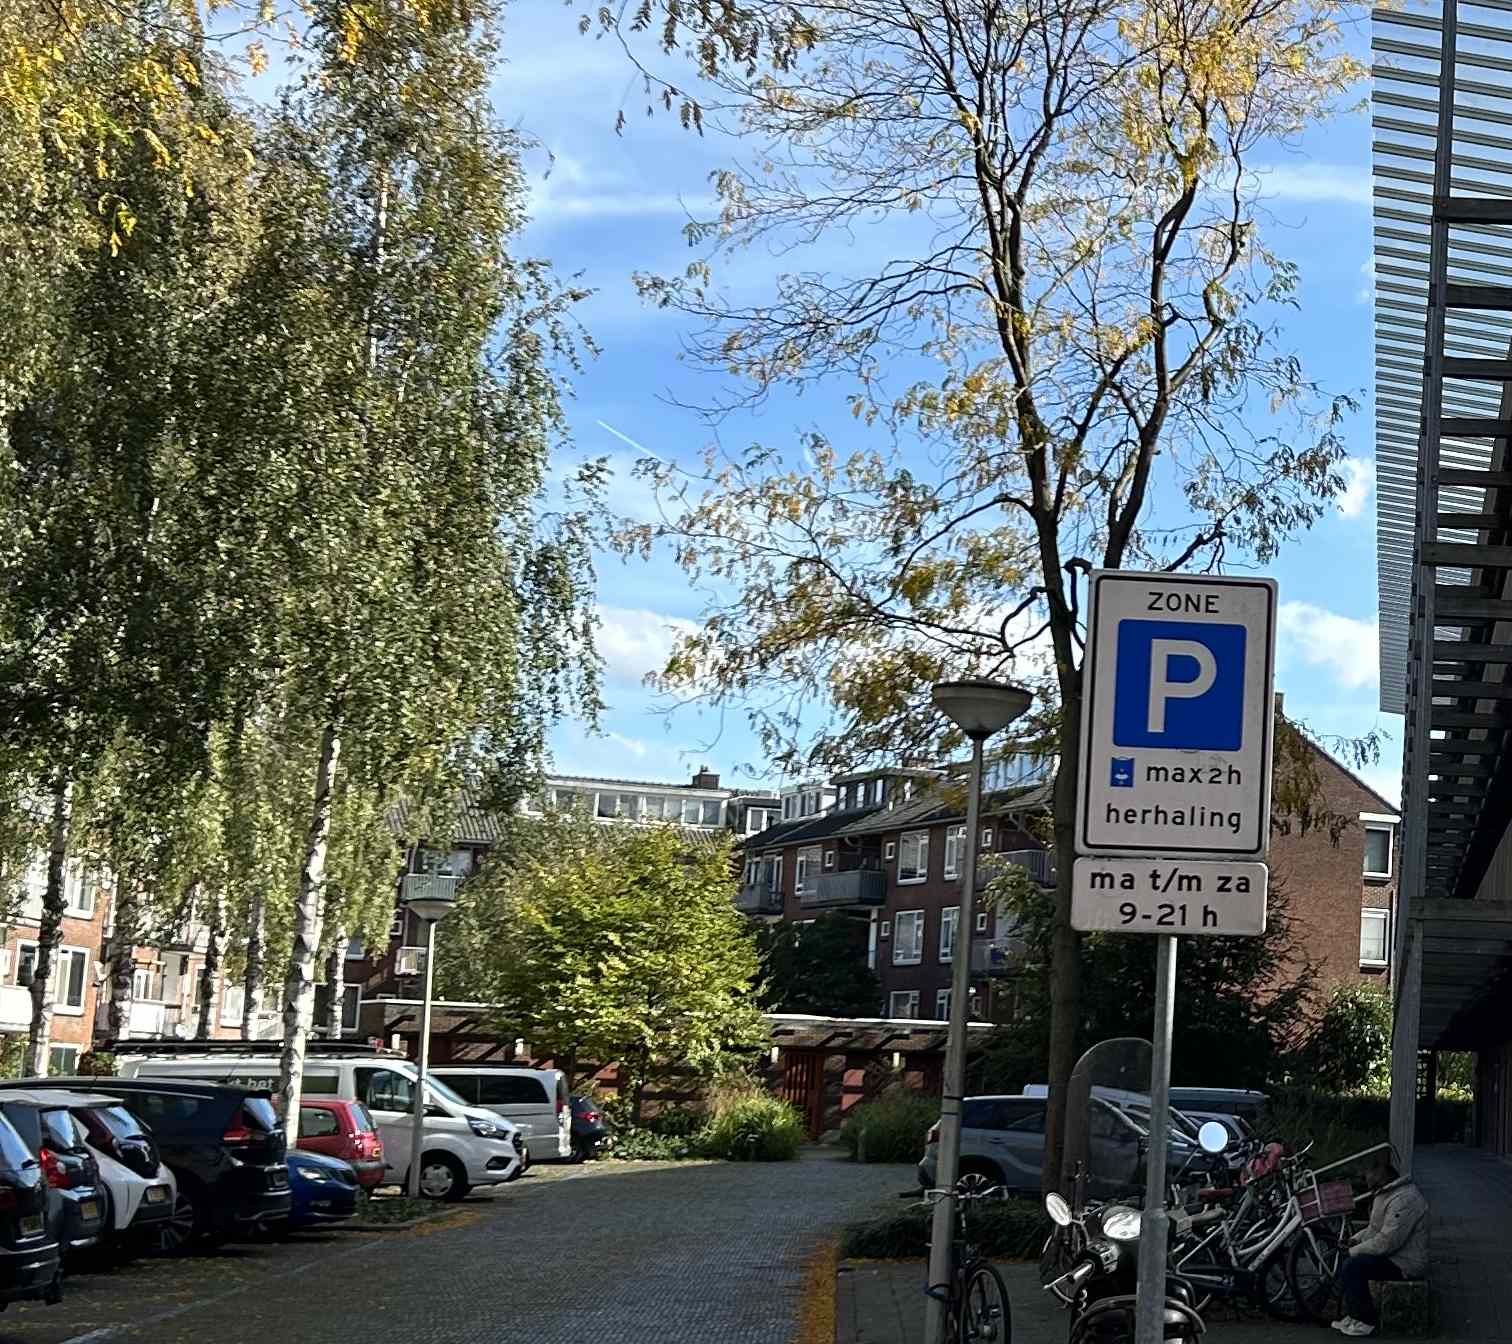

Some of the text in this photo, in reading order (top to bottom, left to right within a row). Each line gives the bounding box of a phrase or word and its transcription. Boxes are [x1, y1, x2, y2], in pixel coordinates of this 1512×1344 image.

[1147, 591, 1220, 614] ZONE
[1147, 638, 1218, 733] P
[1105, 802, 1241, 834] herhaling
[1090, 867, 1250, 893] ma t/m za
[1119, 902, 1218, 927] 9-21 h
